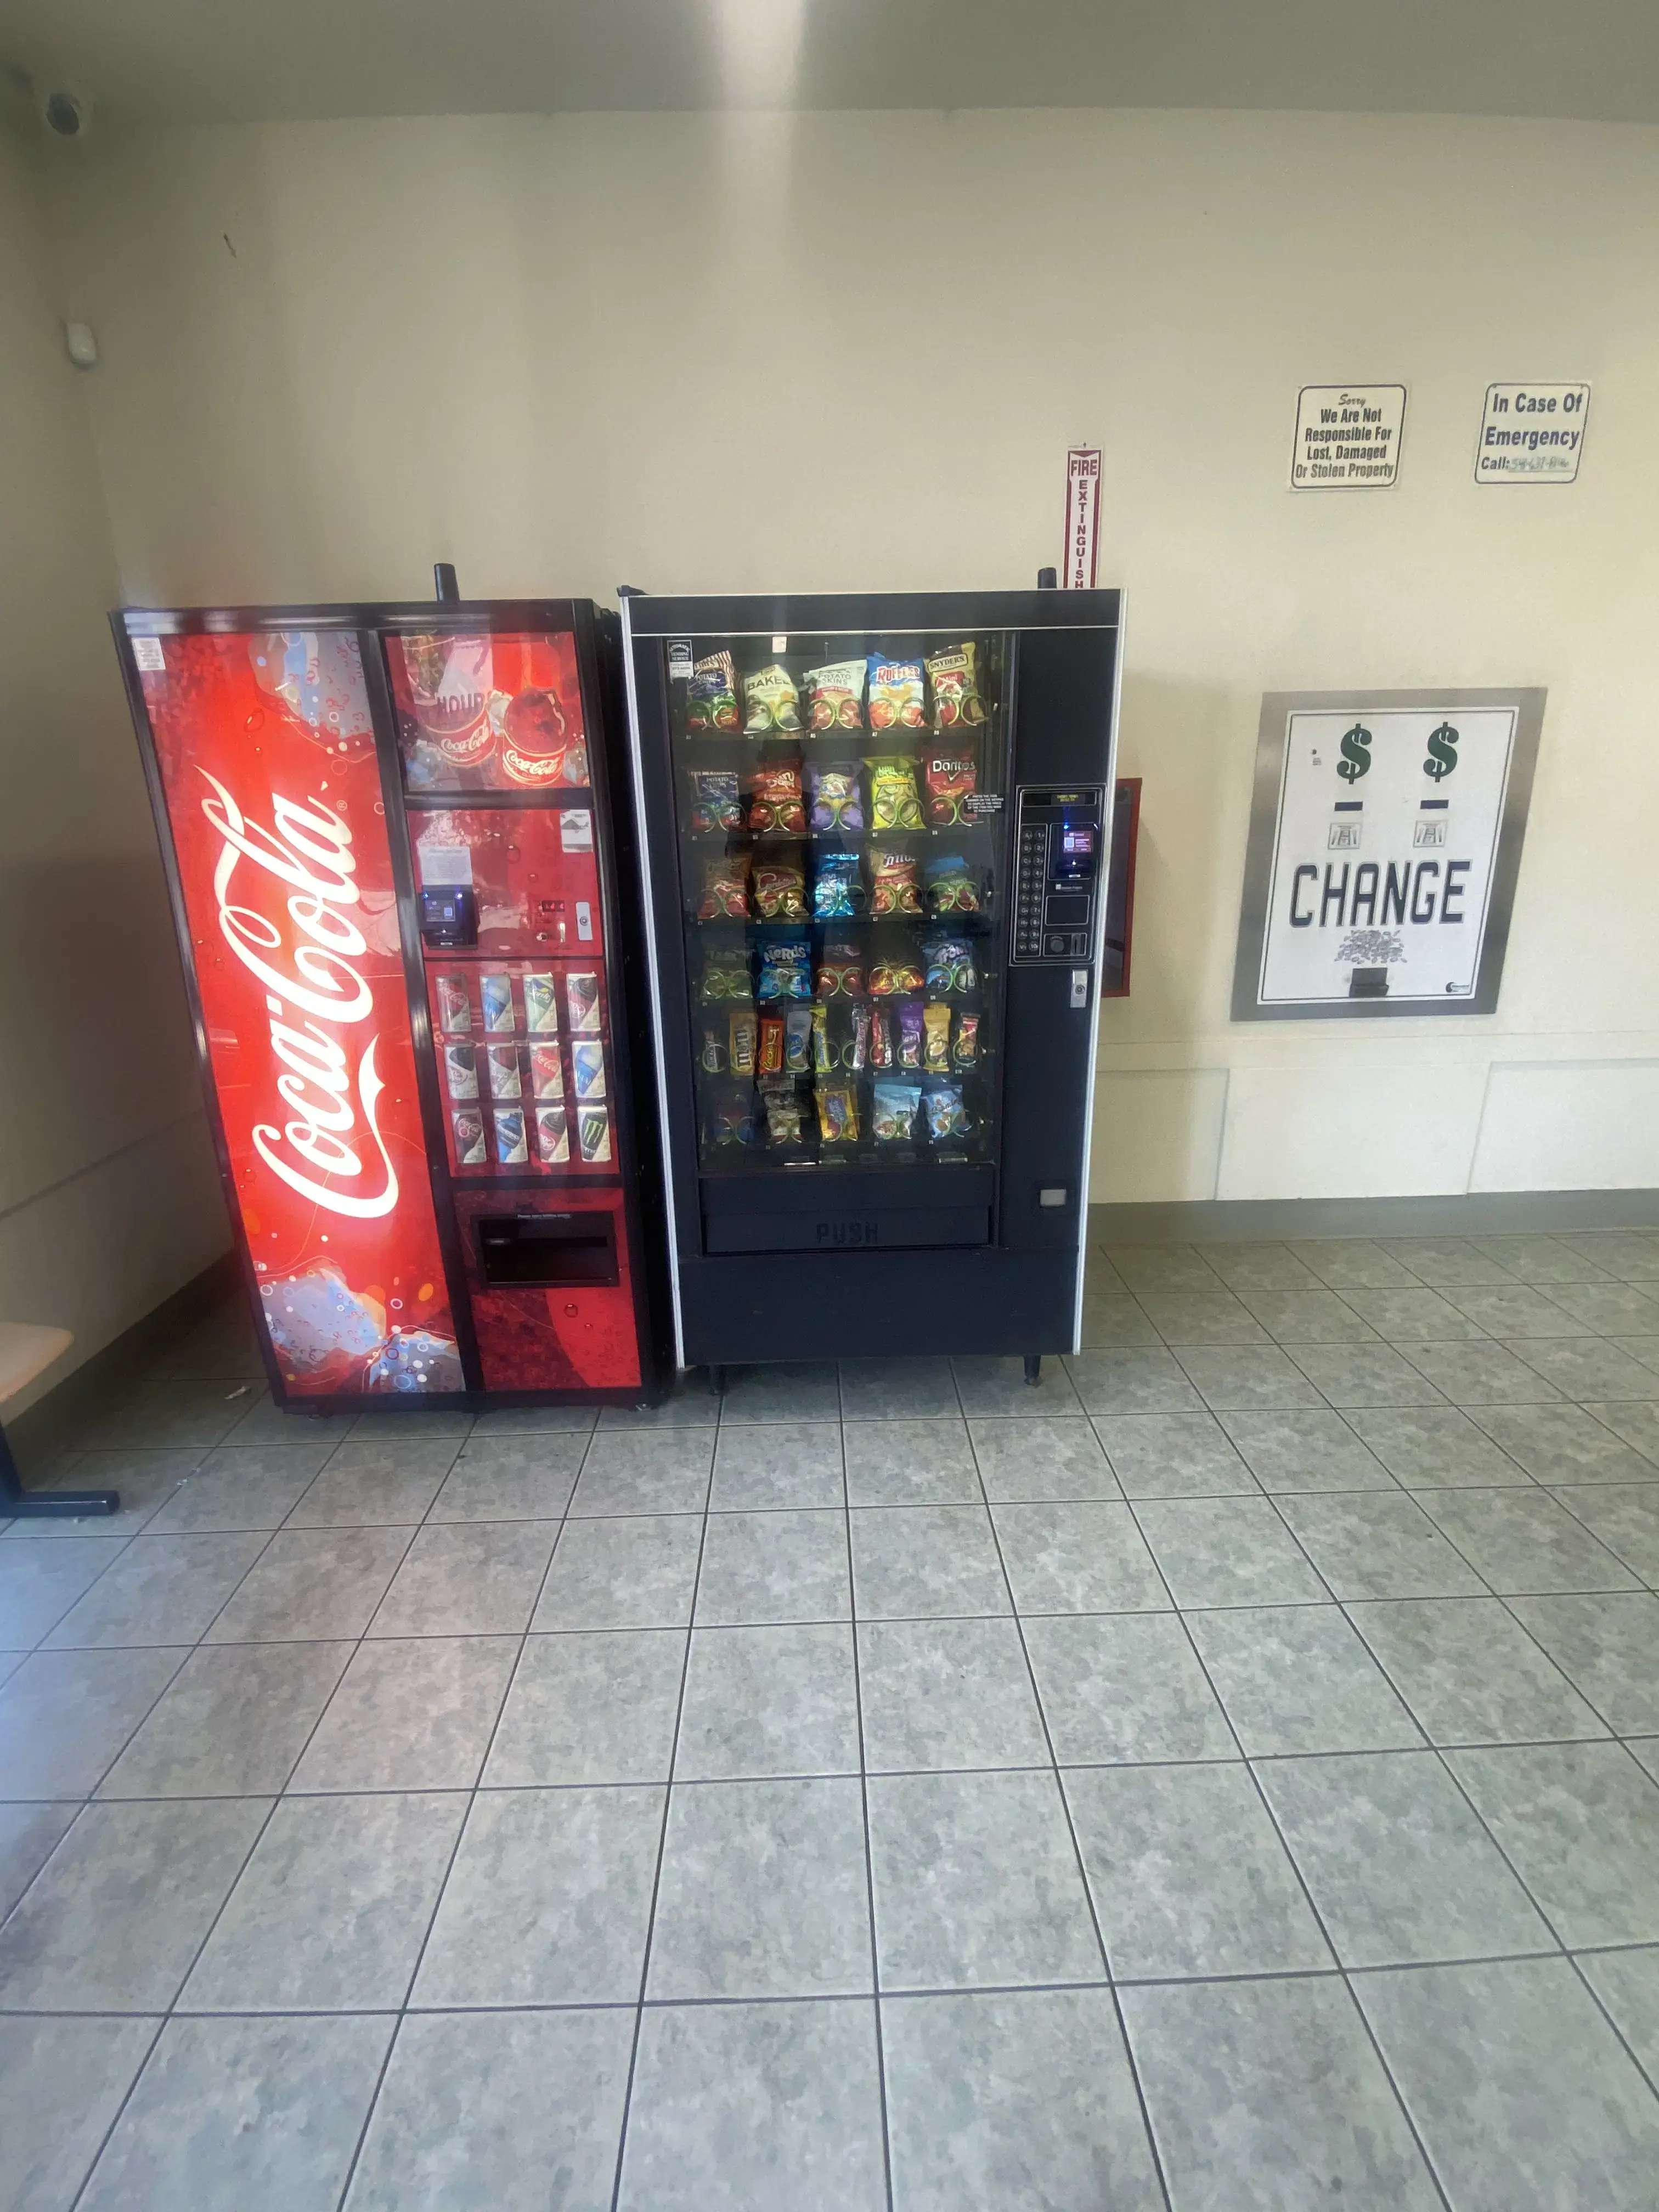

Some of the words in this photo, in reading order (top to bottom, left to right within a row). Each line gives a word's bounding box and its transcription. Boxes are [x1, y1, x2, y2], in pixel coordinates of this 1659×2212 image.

[1339, 393, 1366, 408] Sorry
[1493, 393, 1509, 412] In
[1515, 393, 1556, 413] Case
[1564, 393, 1583, 413] Of
[1321, 409, 1338, 423] We
[1341, 409, 1359, 423] Are
[1363, 408, 1381, 422] Not
[1305, 426, 1372, 442] Responsible
[1375, 426, 1392, 441] For
[1485, 426, 1579, 450] Emergency
[1307, 446, 1331, 461] Lost,
[1335, 444, 1387, 460] Damaged
[1071, 459, 1097, 476] FIRE
[1295, 464, 1308, 478] Or
[1311, 464, 1345, 478] Stolen
[1348, 463, 1394, 478] Property
[1481, 456, 1510, 470] Call:
[506, 749, 563, 776] Coca-Cola
[933, 760, 976, 772] Doritos
[1289, 860, 1472, 927] CHANGE
[193, 764, 399, 1220] Coca-Cola
[816, 1222, 878, 1244] PUSH
